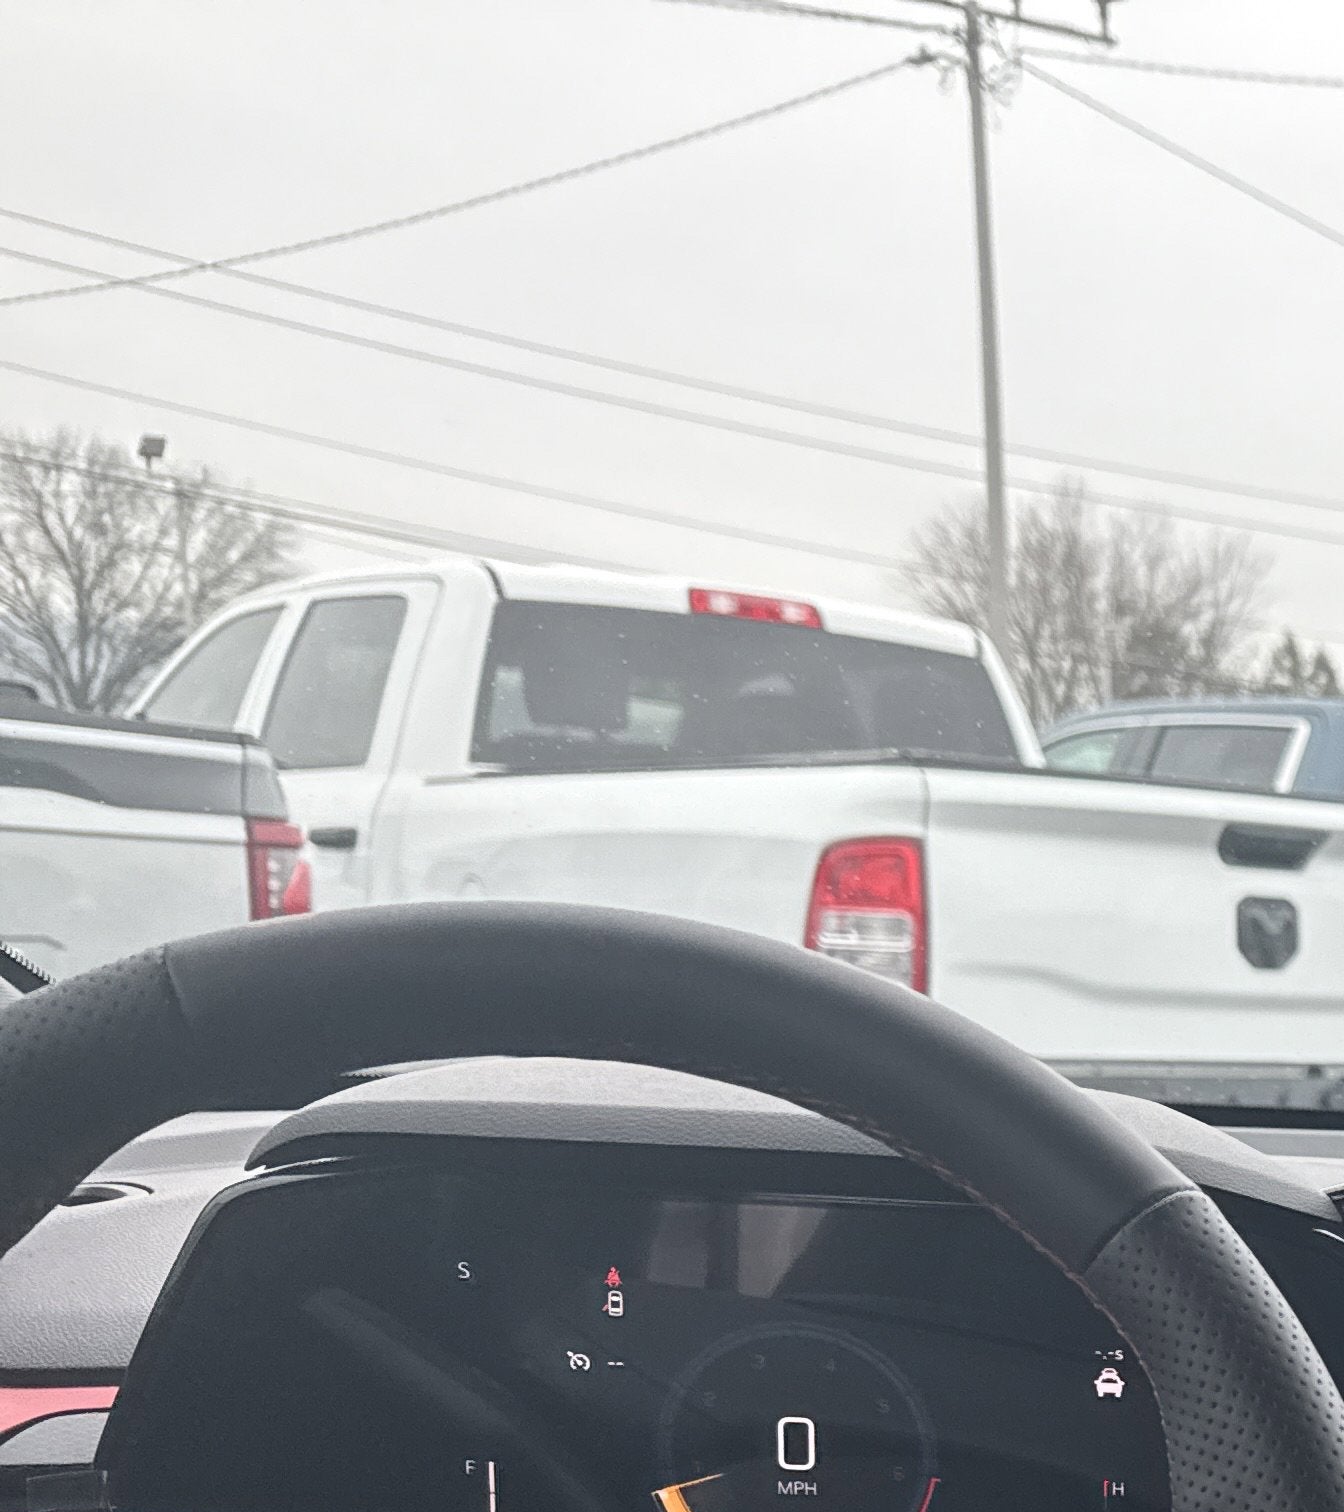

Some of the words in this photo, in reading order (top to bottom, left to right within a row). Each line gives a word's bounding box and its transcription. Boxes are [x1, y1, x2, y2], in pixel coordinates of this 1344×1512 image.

[458, 1262, 471, 1280] S
[777, 1417, 816, 1471] 0
[465, 1460, 476, 1474] F
[777, 1481, 818, 1496] MPH
[1112, 1482, 1125, 1496] H
